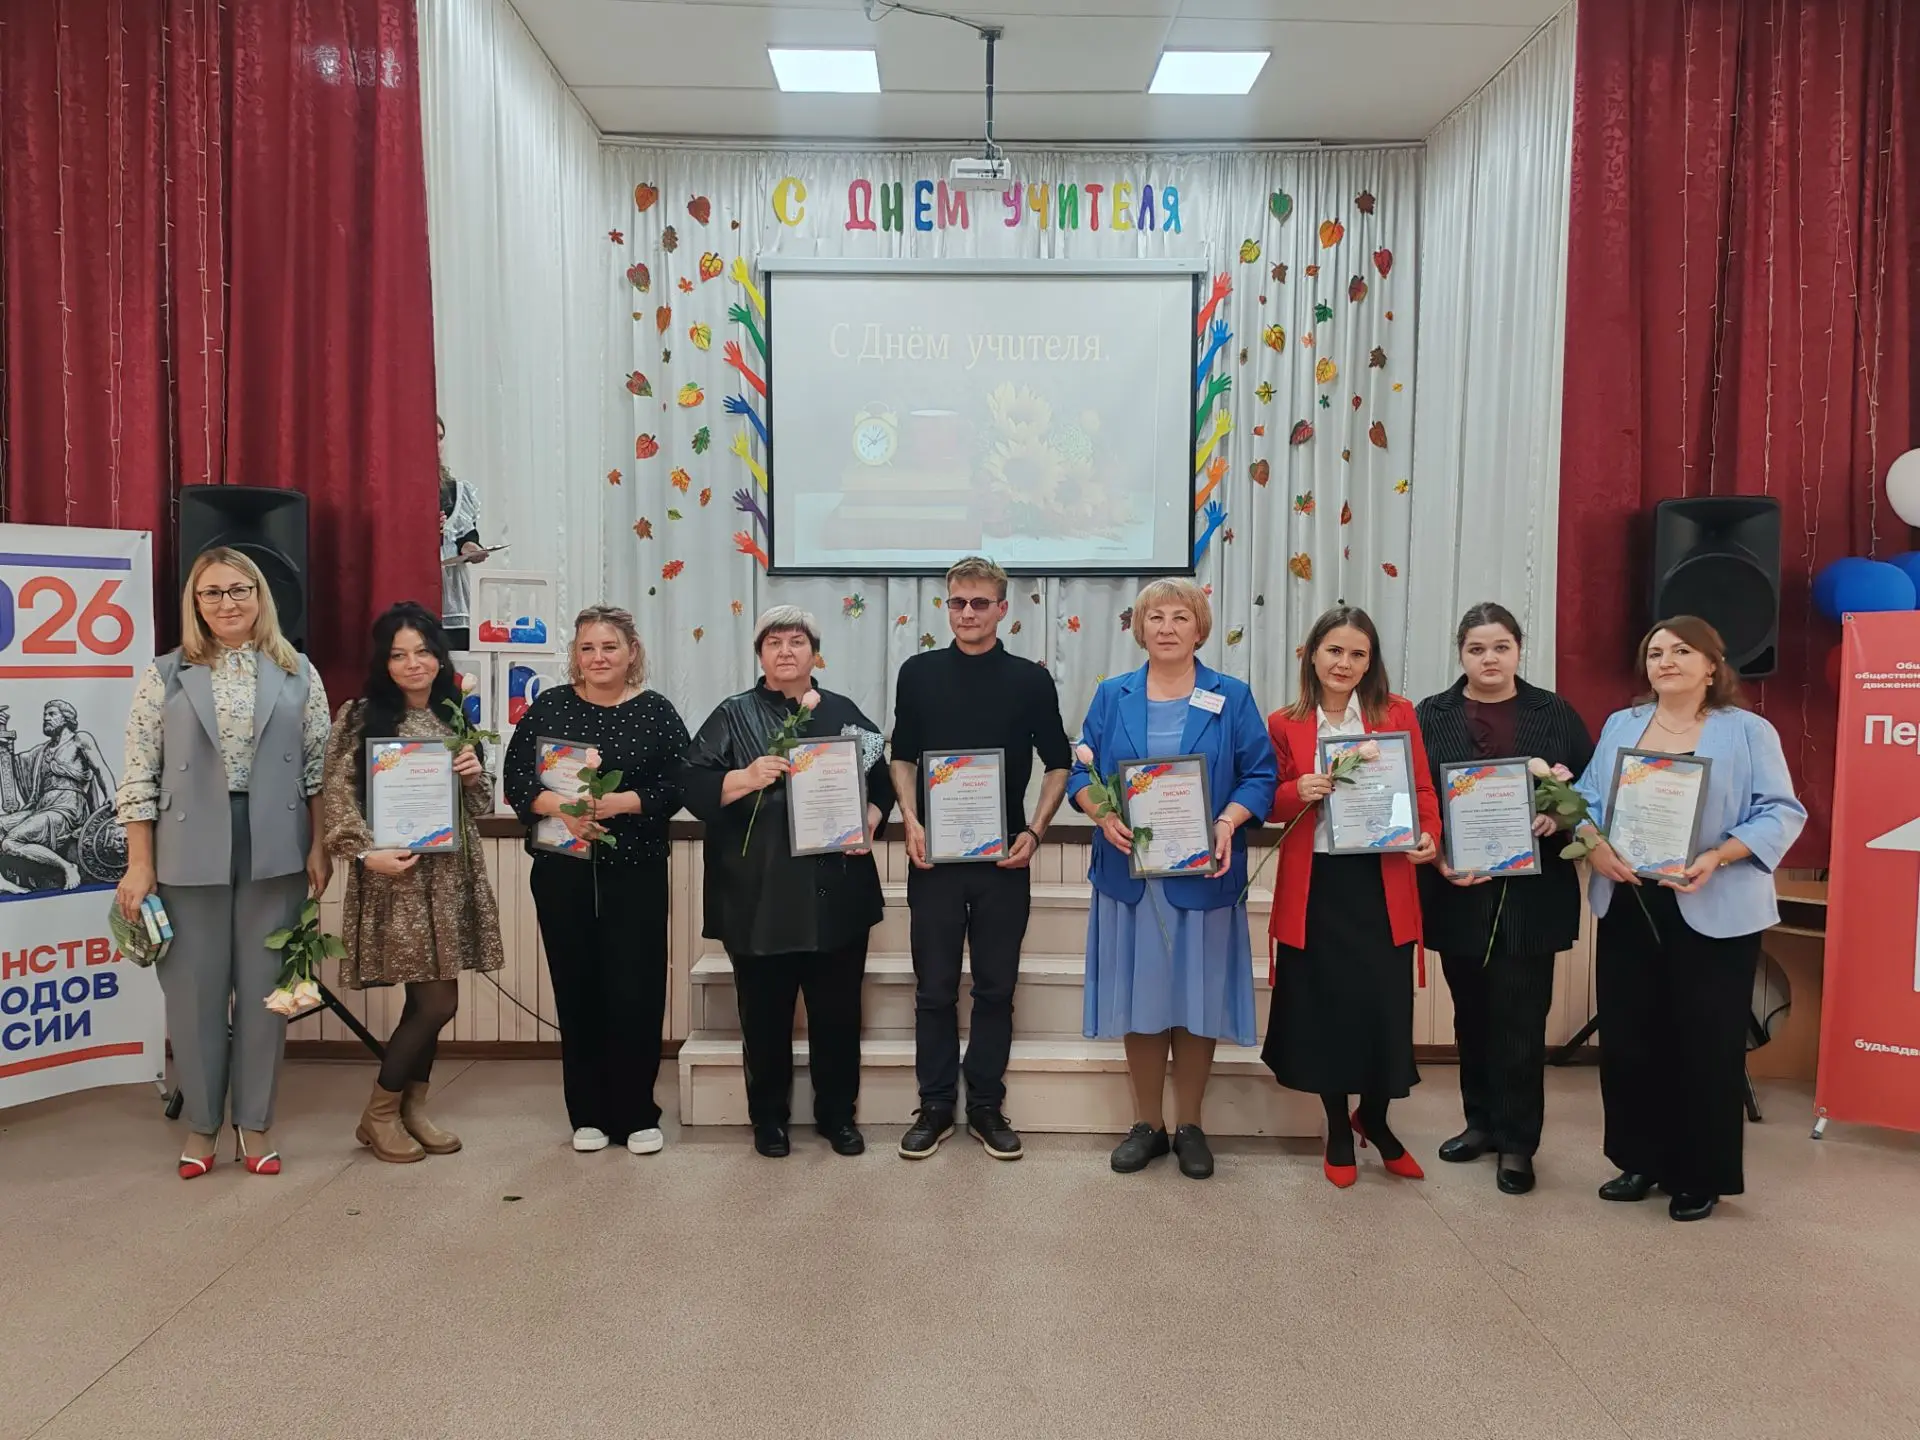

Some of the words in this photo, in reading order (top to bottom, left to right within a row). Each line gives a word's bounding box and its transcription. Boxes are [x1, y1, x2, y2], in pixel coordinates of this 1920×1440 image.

[772, 177, 807, 226] С
[845, 179, 969, 231] ДНЕМ
[1002, 180, 1182, 234] УЧИТЕЛЯ
[829, 322, 850, 358] С
[857, 323, 950, 366] Днём
[1864, 714, 1920, 755] Пе
[0, 971, 119, 1016] ОДОВ
[2, 1009, 91, 1051] СИИ
[1854, 1038, 1920, 1057] будьвдв
